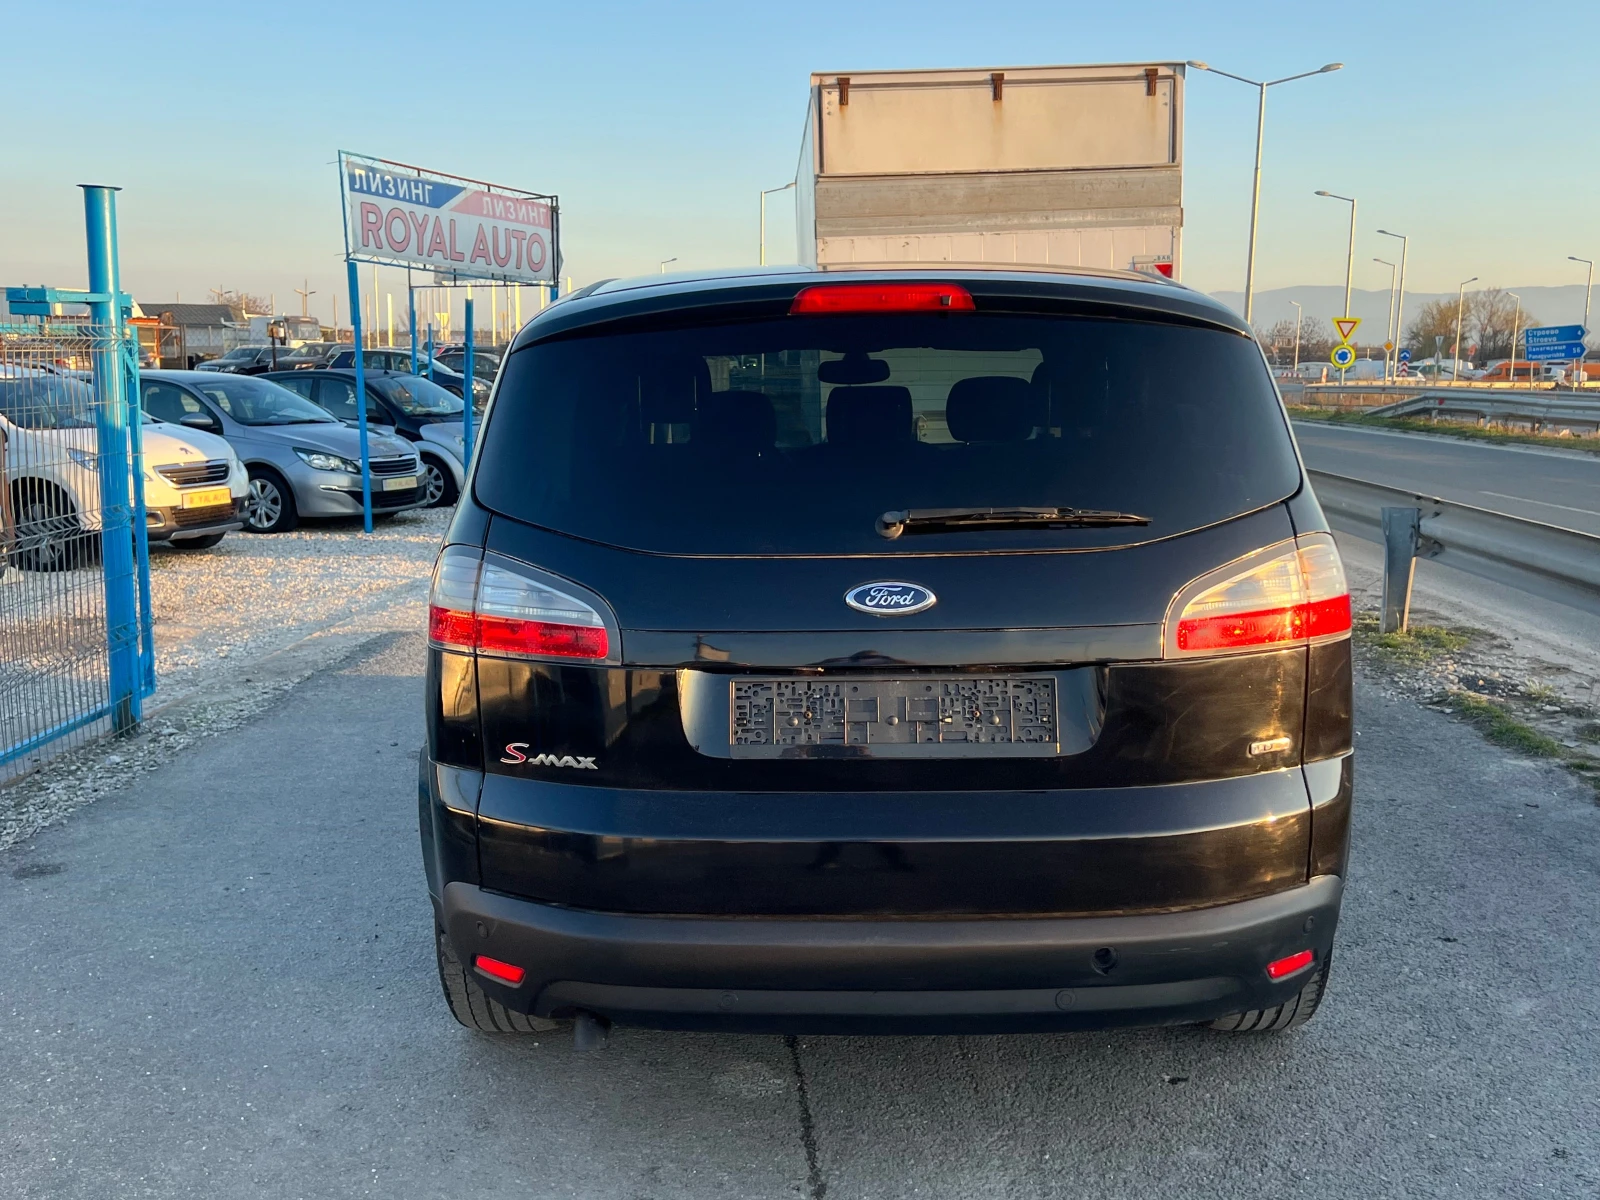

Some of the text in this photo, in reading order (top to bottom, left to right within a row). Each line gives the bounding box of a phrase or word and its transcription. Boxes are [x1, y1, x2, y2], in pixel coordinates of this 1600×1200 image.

[354, 168, 433, 204] ЛИЗИНГ
[482, 196, 547, 225] ЛИЗИНГ
[360, 201, 546, 273] ROYAL AUTO
[865, 586, 915, 606] Ford
